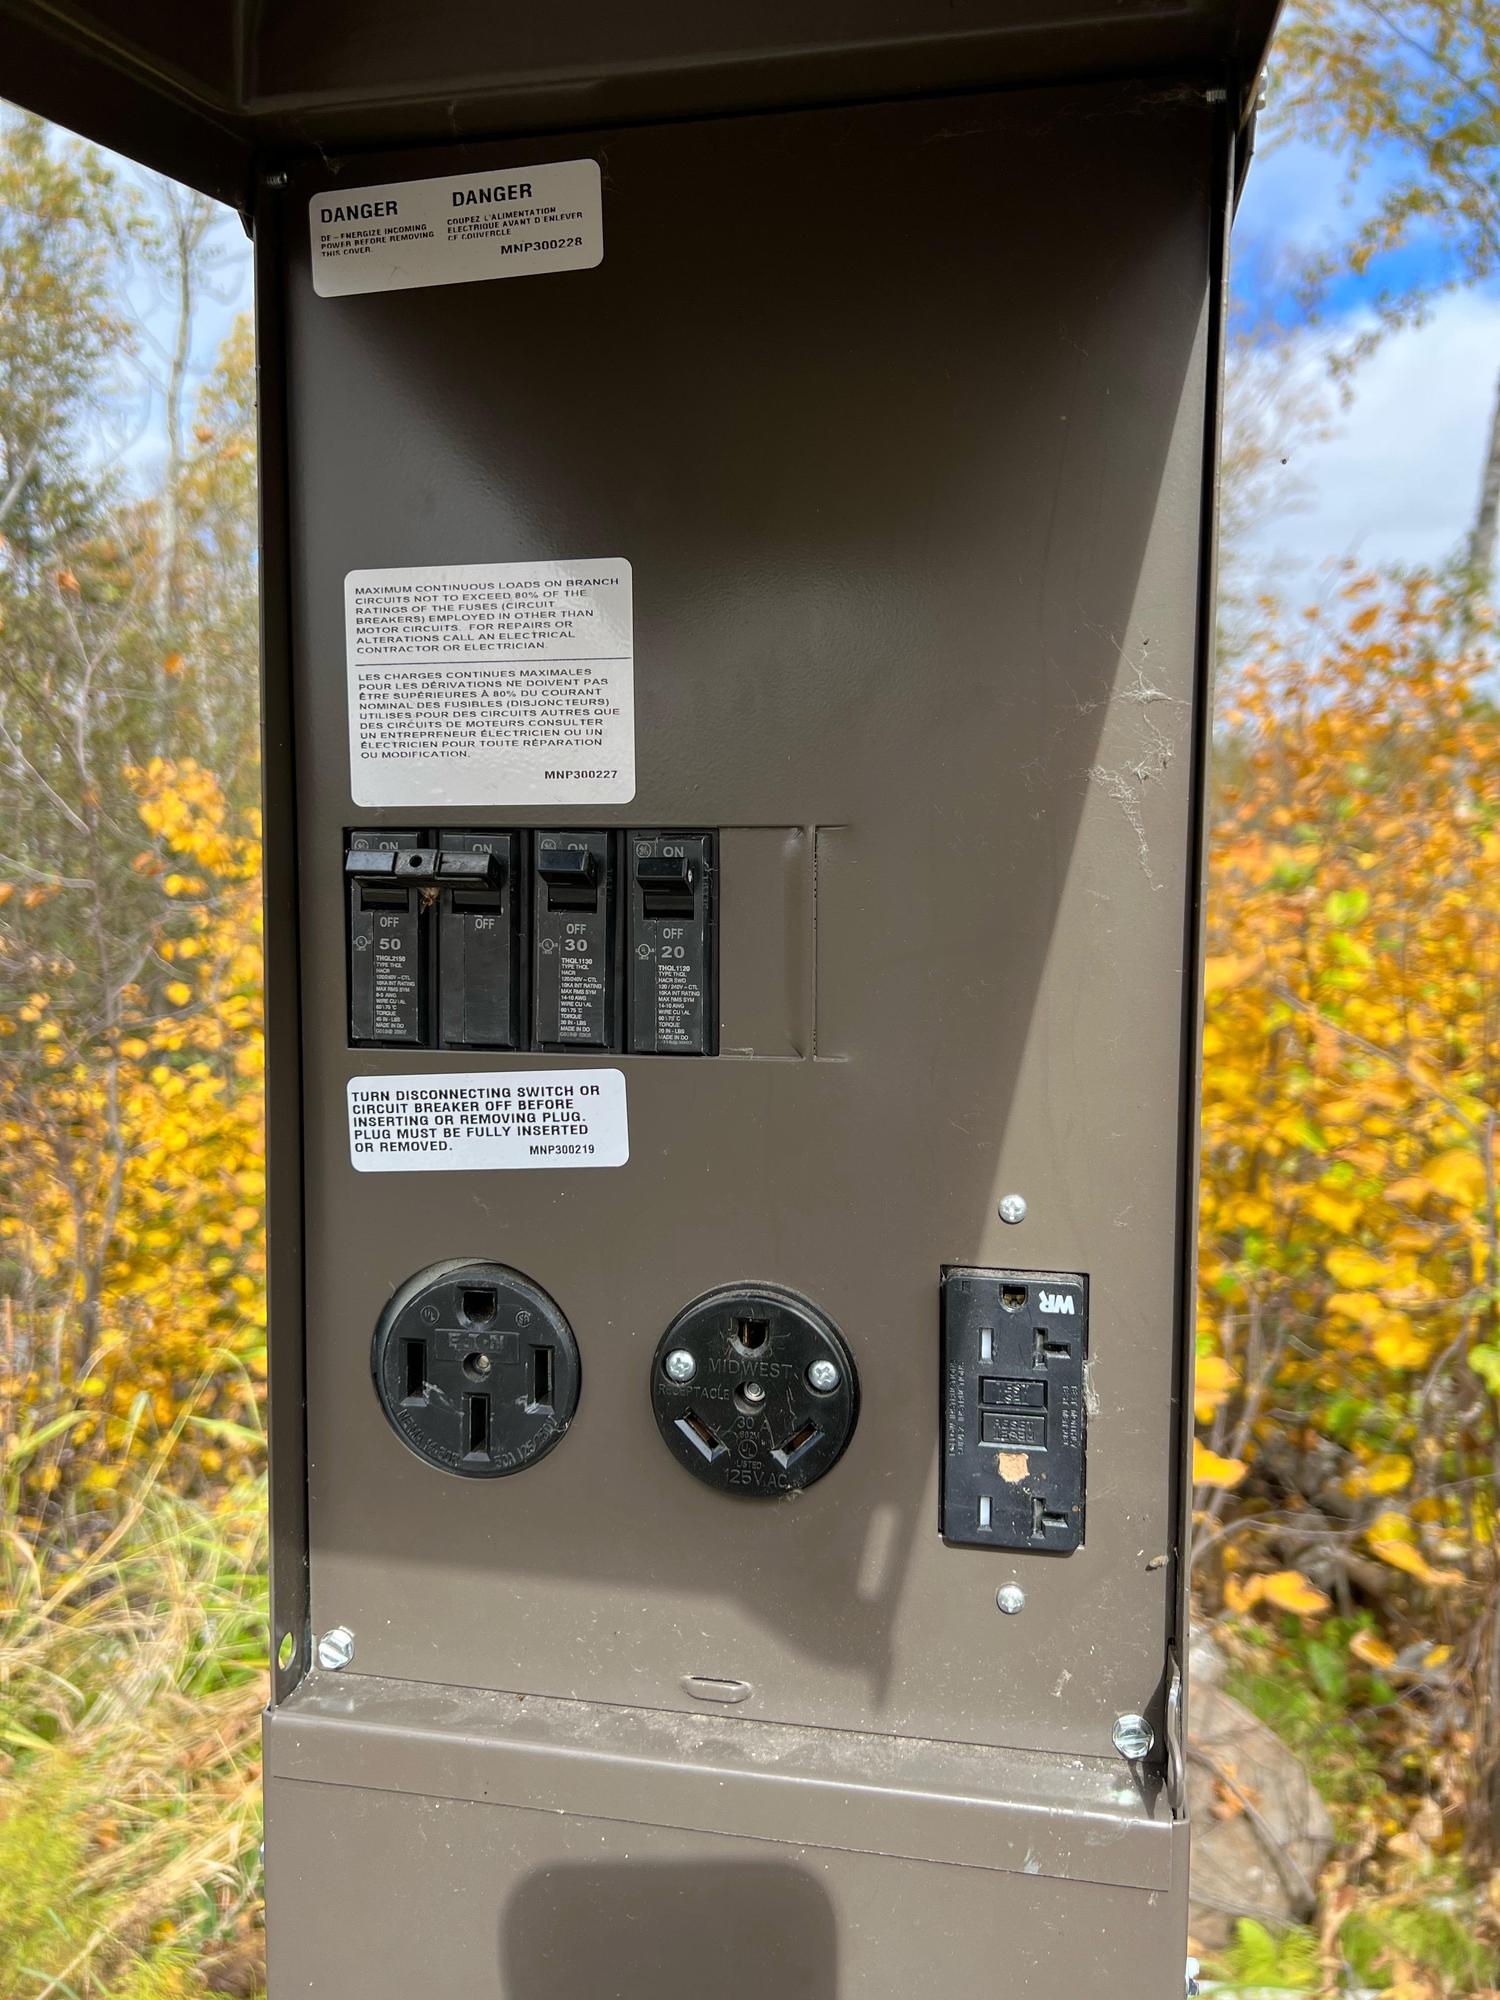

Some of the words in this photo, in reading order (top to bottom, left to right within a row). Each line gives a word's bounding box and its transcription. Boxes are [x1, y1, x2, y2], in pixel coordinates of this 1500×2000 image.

[452, 183, 532, 207] DANGER
[321, 200, 398, 223] DANGER
[447, 215, 480, 226] COUPEZ
[484, 207, 556, 222] L'ALIMENTATION
[384, 223, 427, 235] INCOMING
[447, 221, 499, 234] ELECTRIQUE
[502, 218, 530, 227] AVANT
[321, 240, 352, 250] POWER
[354, 236, 386, 246] BEFORE
[389, 231, 434, 242] REMOVING
[501, 237, 583, 255] MNP300228
[355, 586, 412, 595] MAXIMUM
[415, 582, 495, 593] CONTINUOUS
[498, 581, 540, 589] LOADS
[566, 578, 619, 587] BRANCH
[355, 596, 410, 605] CIRCUITS
[462, 592, 511, 601] EXCEED
[355, 606, 408, 615] RATINGS
[458, 603, 498, 611] FUSES
[501, 601, 554, 611] (CIRCUIT
[356, 615, 425, 625] BREAKERS)
[428, 613, 495, 622] EMPLOYED
[514, 611, 556, 620] OTHER
[561, 610, 594, 618] THAN
[356, 626, 399, 634] MOTOR
[498, 621, 551, 630] REPAIRS
[356, 635, 440, 644] ALTERATIONS
[443, 634, 474, 642] CALL
[499, 631, 575, 640] ELECTRICAL
[357, 645, 439, 654] CONTRACTOR
[384, 672, 442, 680] CHARGES
[446, 670, 516, 679] CONTINUES
[520, 668, 592, 677] MAXIMALES
[422, 680, 502, 689] DÉRIVATIONS
[526, 678, 579, 687] DOIVENT
[393, 691, 477, 700] SUPÉRIEURES
[481, 689, 490, 698] À
[541, 688, 602, 697] COURANT
[444, 700, 503, 708] FUSIBLES
[506, 698, 610, 709] (DISJONCTEURS)
[480, 710, 537, 718] CIRCUITS
[540, 708, 590, 717] AUTRES
[387, 720, 442, 729] CIRCUITS
[528, 718, 603, 727] CONSULTER
[380, 730, 476, 739] ENTREPRENEUR
[480, 729, 560, 738] ÉLECTRICIEN
[361, 741, 438, 749] ÉLECTRICIEN
[523, 738, 602, 747] RÉPARATION
[381, 750, 470, 759] MODIFICATION.
[544, 770, 618, 779] MNP300227
[379, 841, 399, 850] ON
[473, 843, 492, 853] ON
[663, 846, 684, 858] ON
[380, 916, 399, 927] OFF
[475, 918, 495, 929] OFF
[566, 924, 587, 935] OFF
[663, 928, 684, 939] OFF
[379, 938, 401, 950] 50
[565, 939, 588, 952] 30
[661, 946, 685, 958] 20
[351, 1091, 390, 1102] TURN
[396, 1088, 511, 1101] DISCONNECTING
[517, 1086, 574, 1098] SWITCH
[580, 1085, 600, 1096] OR
[352, 1103, 408, 1115] CIRCUIT
[414, 1101, 479, 1113] BREAKER
[485, 1100, 512, 1111] OFF
[518, 1099, 573, 1110] BEFORE
[354, 1115, 429, 1127] INSERTING
[434, 1115, 454, 1125] OR
[460, 1112, 536, 1125] REMOVING
[542, 1111, 586, 1122] PLUG.
[354, 1129, 391, 1140] PLUG
[397, 1128, 437, 1139] MUST
[443, 1127, 460, 1138] BE
[466, 1126, 511, 1137] FULLY
[517, 1124, 588, 1136] INSERTED
[355, 1142, 374, 1152] OR
[380, 1140, 452, 1152] REMOVED.
[530, 1144, 595, 1155] MNP300219
[1038, 1290, 1075, 1315] WR
[708, 1358, 793, 1379] MIDWEST
[737, 1416, 754, 1429] 30
